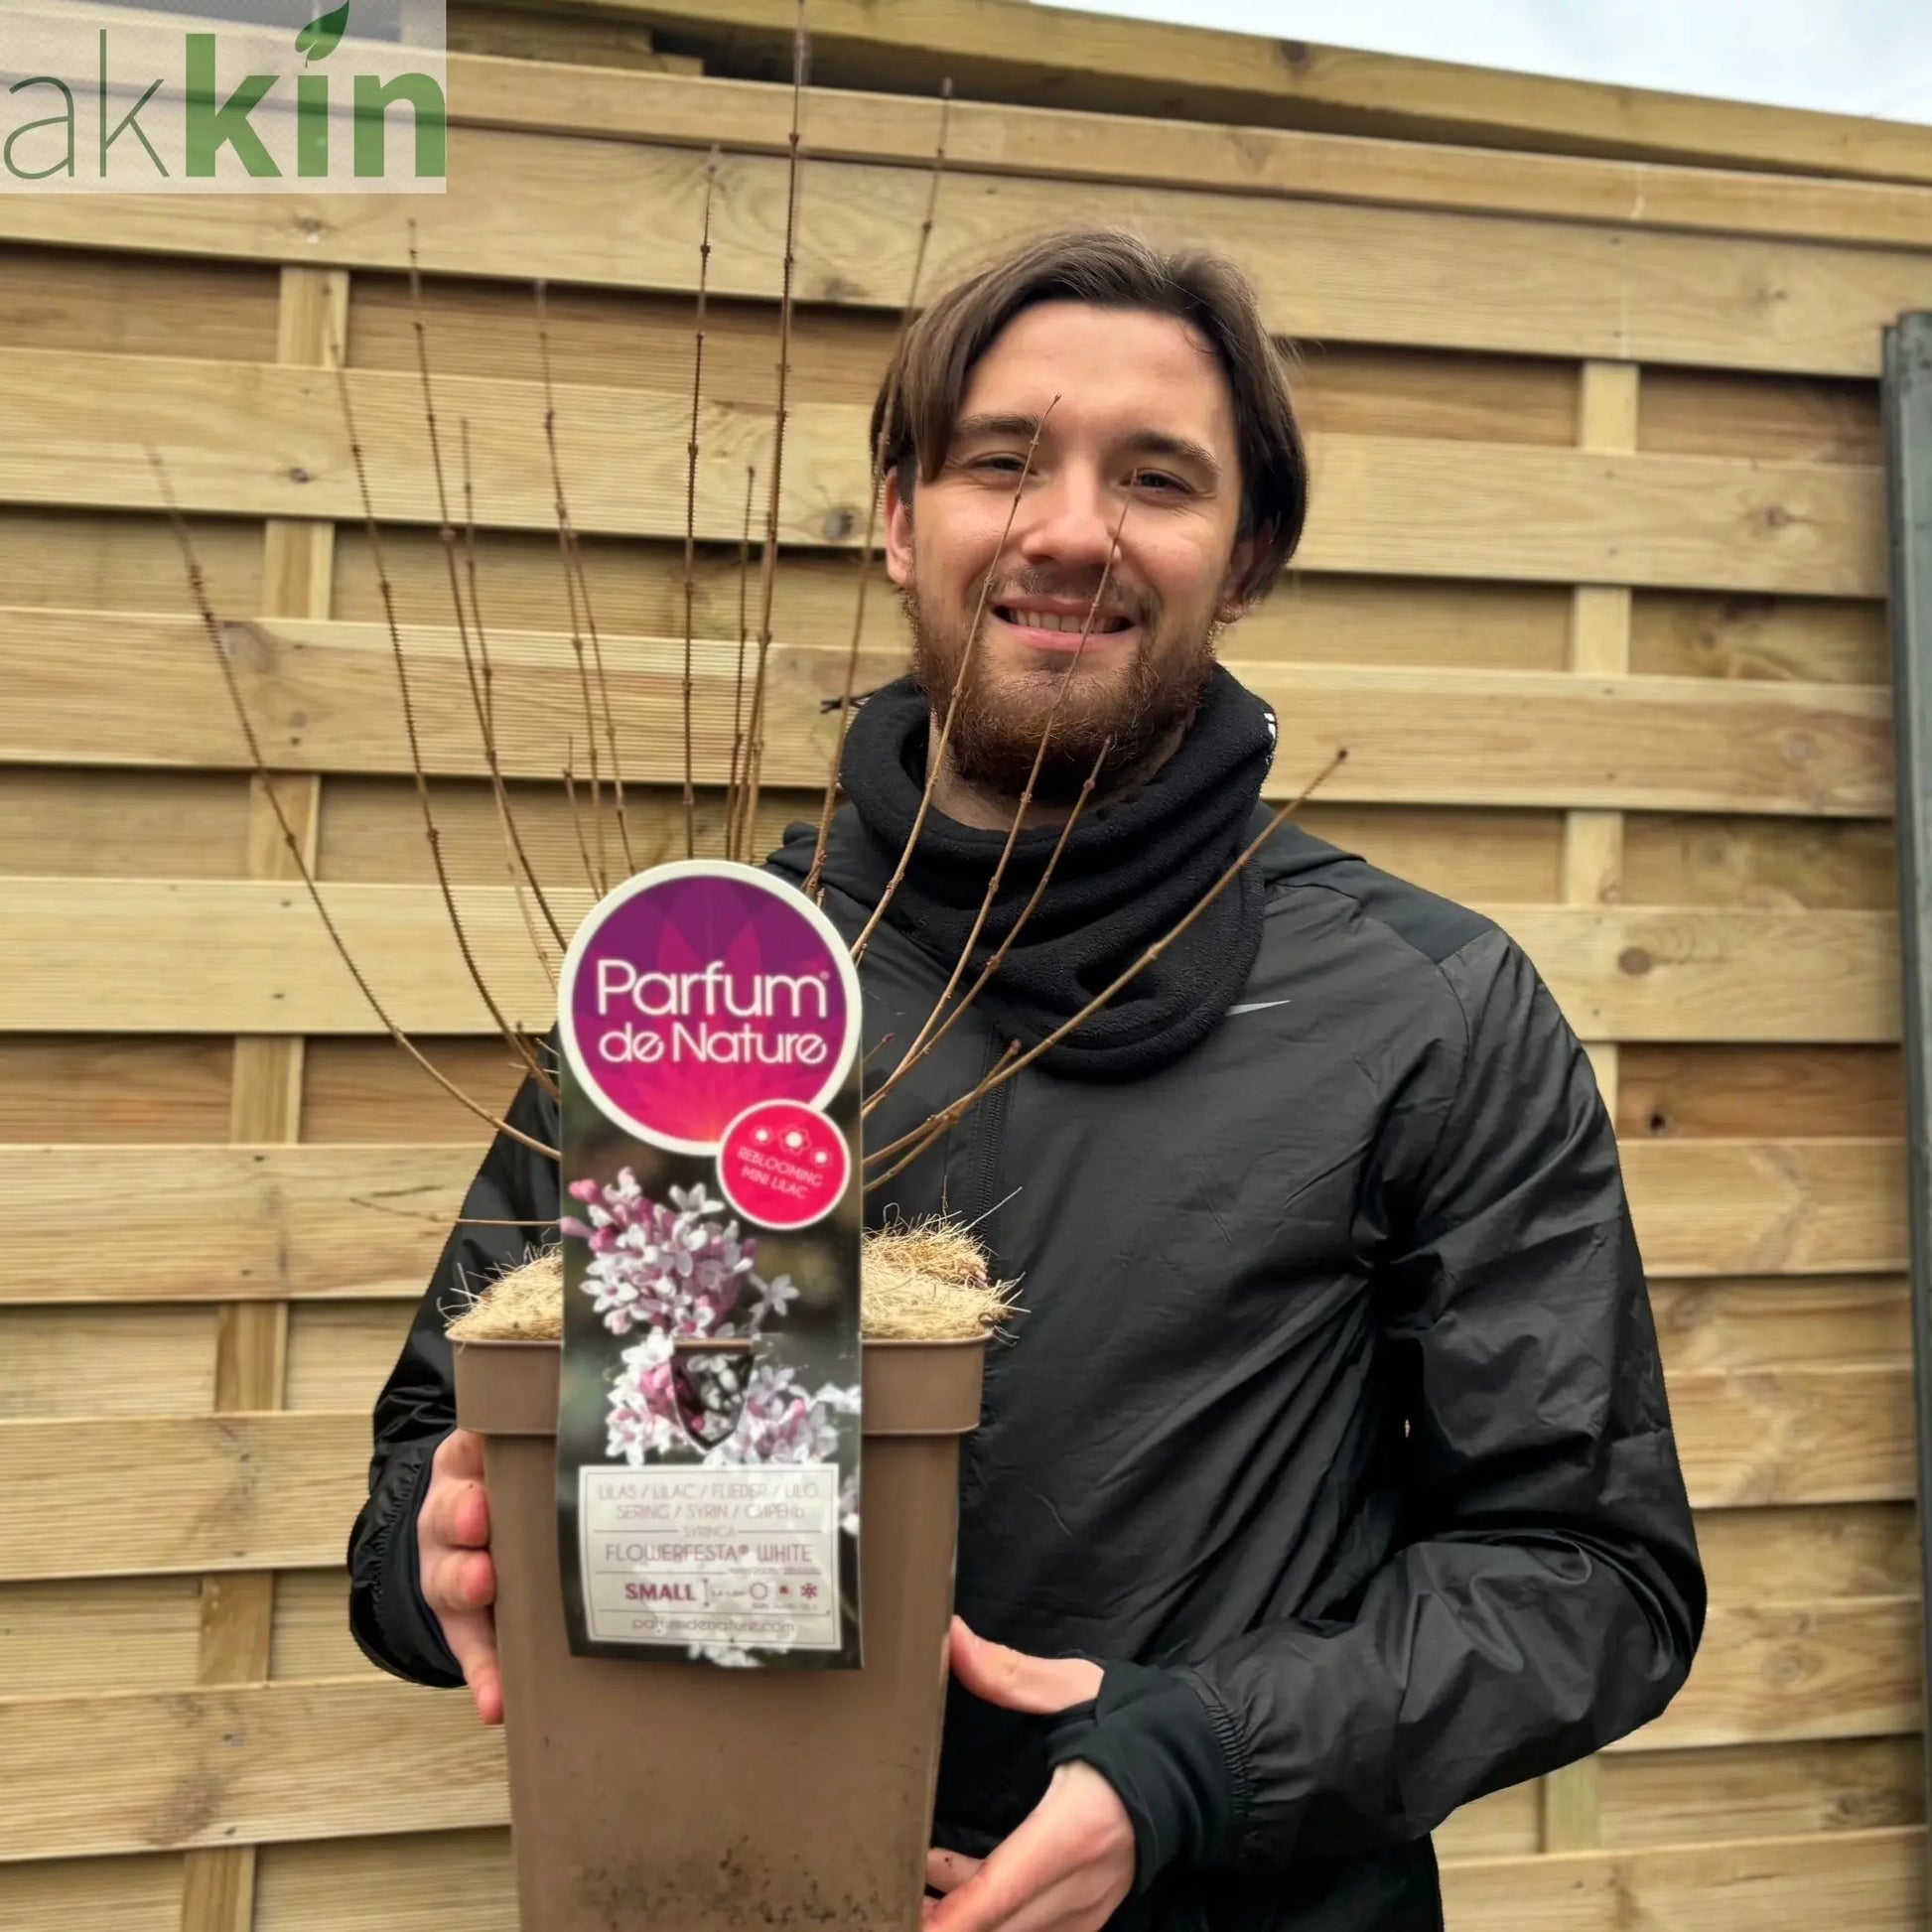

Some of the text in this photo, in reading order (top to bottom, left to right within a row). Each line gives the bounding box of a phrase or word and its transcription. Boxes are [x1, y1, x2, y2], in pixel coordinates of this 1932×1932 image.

[599, 1023, 827, 1064] de Nature
[737, 1147, 823, 1186] REBLOOMING
[740, 1166, 808, 1199] MINI LILAC
[598, 1483, 636, 1499] LILAS
[653, 1483, 695, 1499] LILAC
[617, 1504, 670, 1519] SERING
[686, 1503, 728, 1519] SYRIN
[758, 1544, 812, 1562] WHITE
[624, 1584, 697, 1600] SMALL
